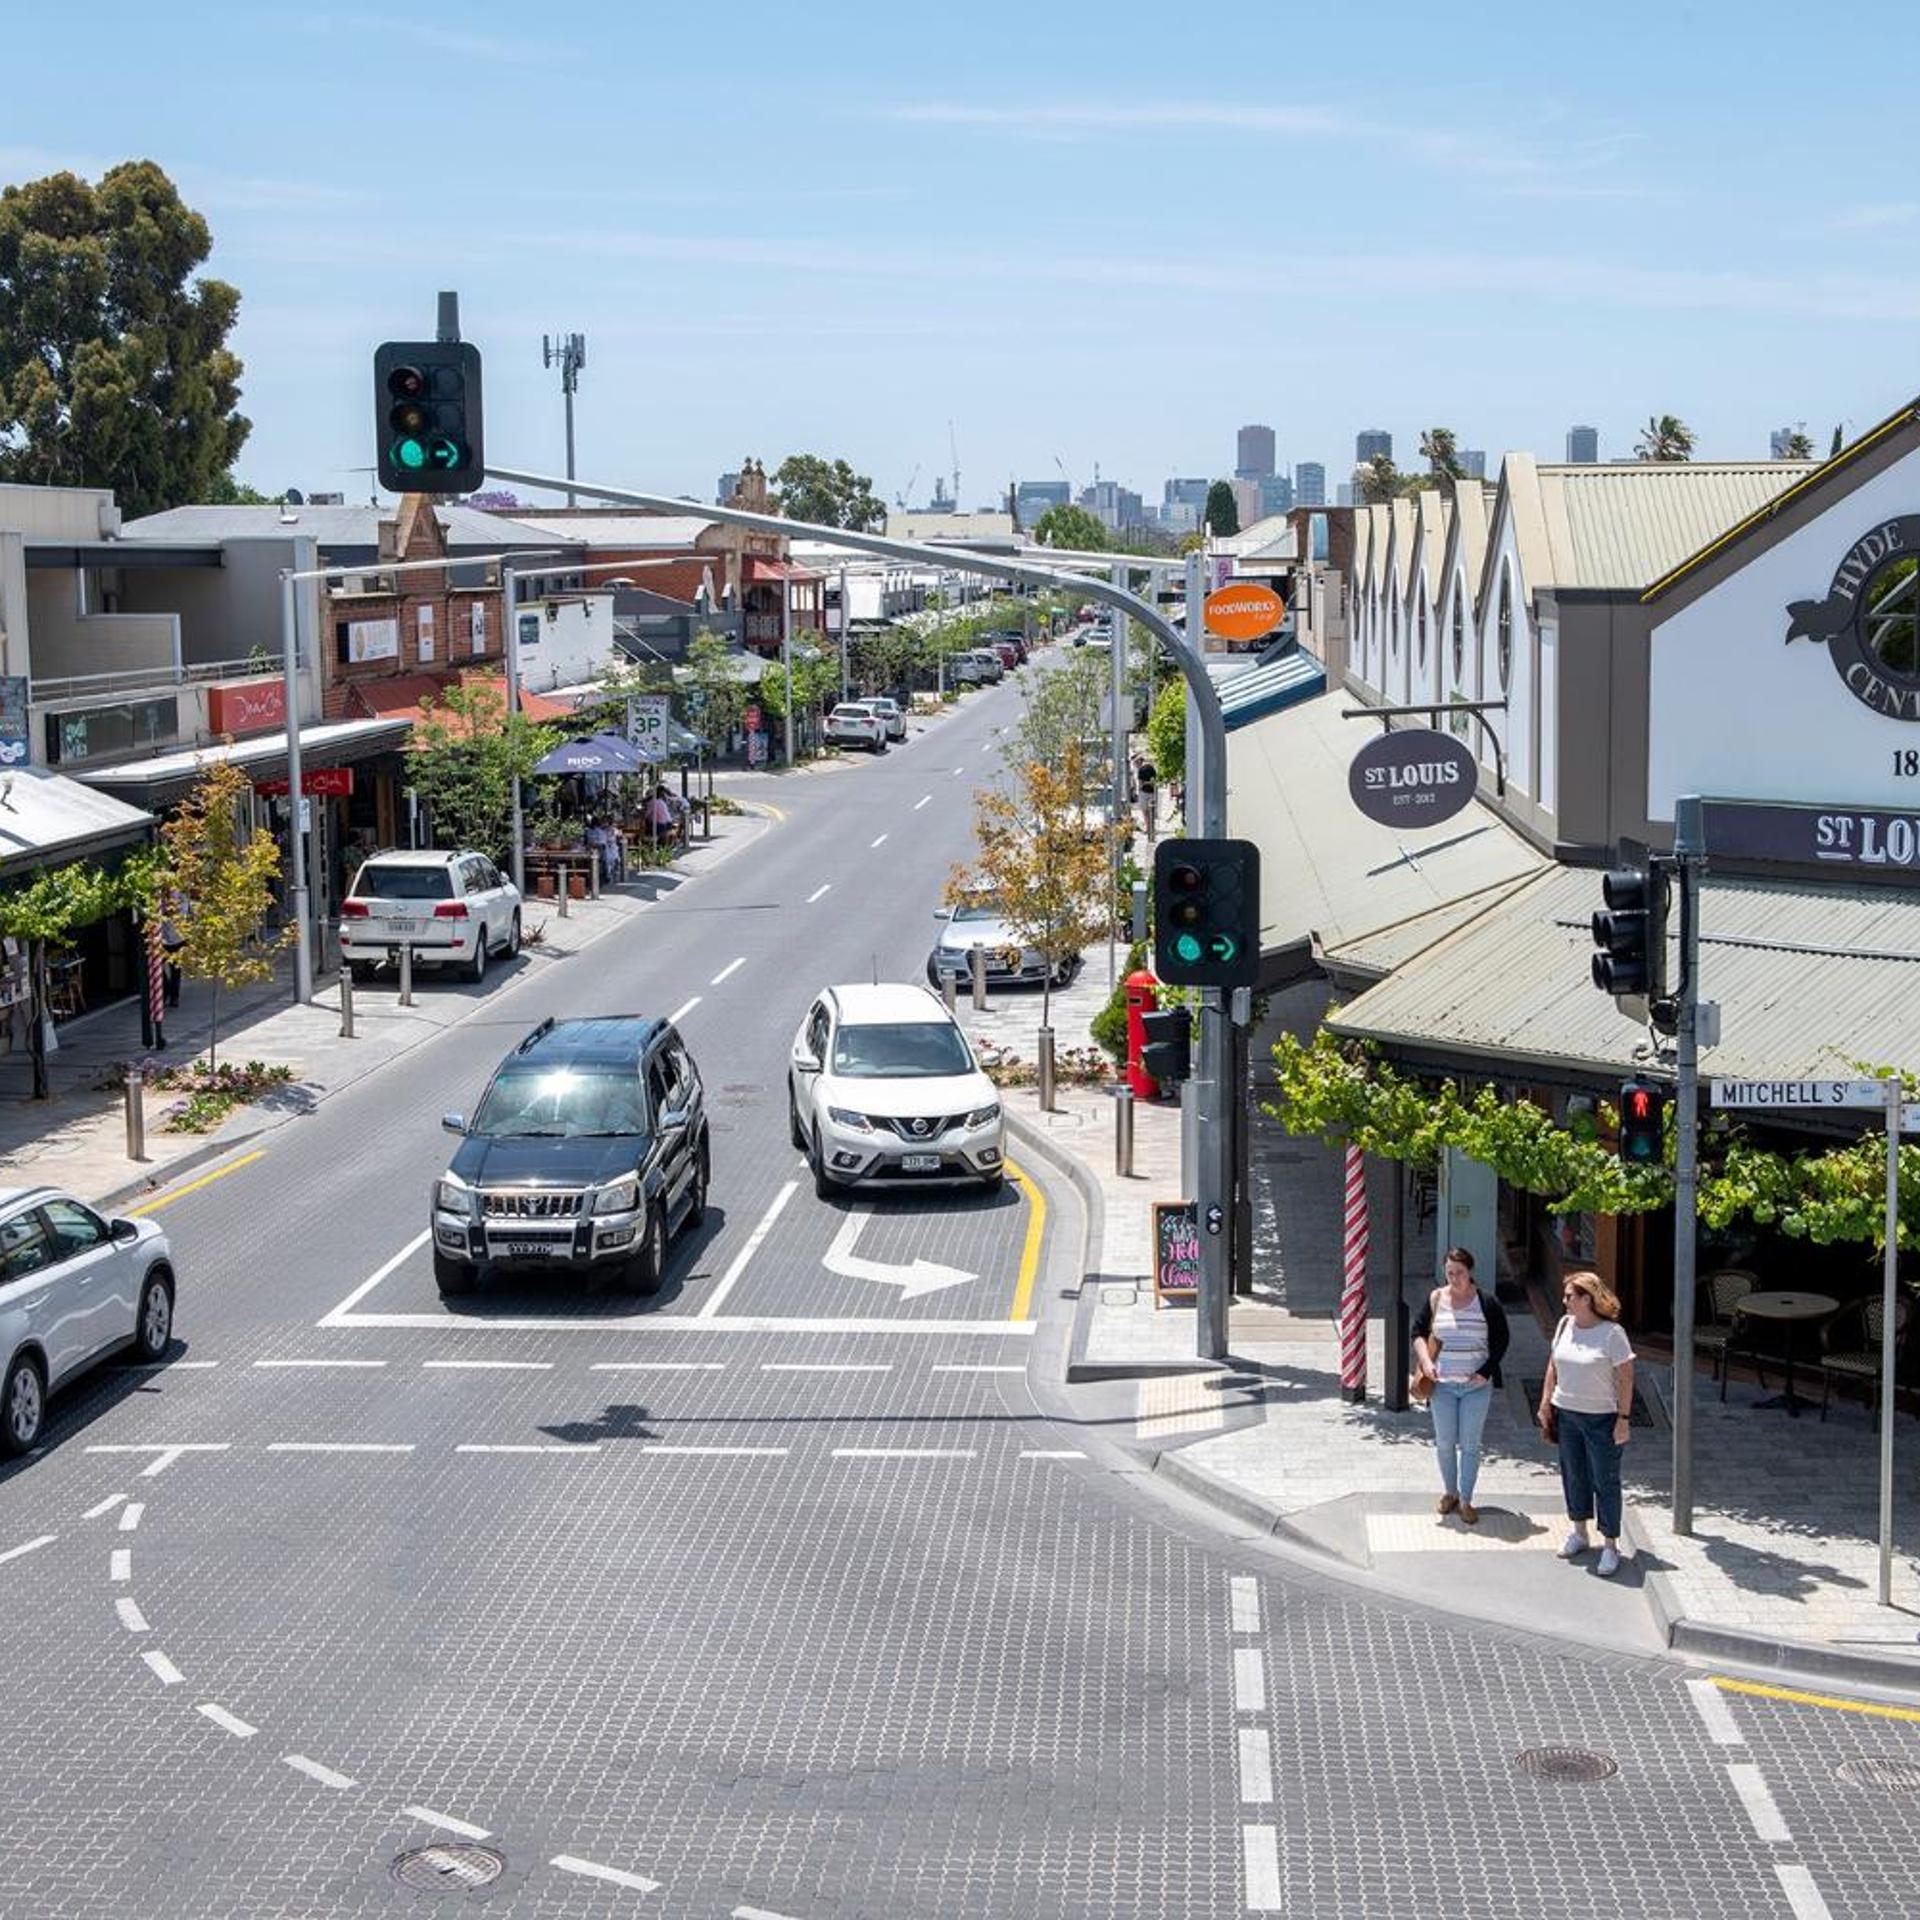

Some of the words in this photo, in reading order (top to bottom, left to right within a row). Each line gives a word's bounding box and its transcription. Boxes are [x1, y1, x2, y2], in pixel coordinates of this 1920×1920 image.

[1831, 522, 1904, 599] HYDE
[1208, 601, 1276, 616] FOODWORKS
[634, 717, 661, 734] 3P
[1364, 766, 1386, 784] ST
[1388, 761, 1460, 789] LOUIS
[1892, 749, 1919, 777] 18
[1816, 815, 1854, 849] ST
[1858, 816, 1920, 865] LO
[1722, 1083, 1823, 1104] MITCHELL
